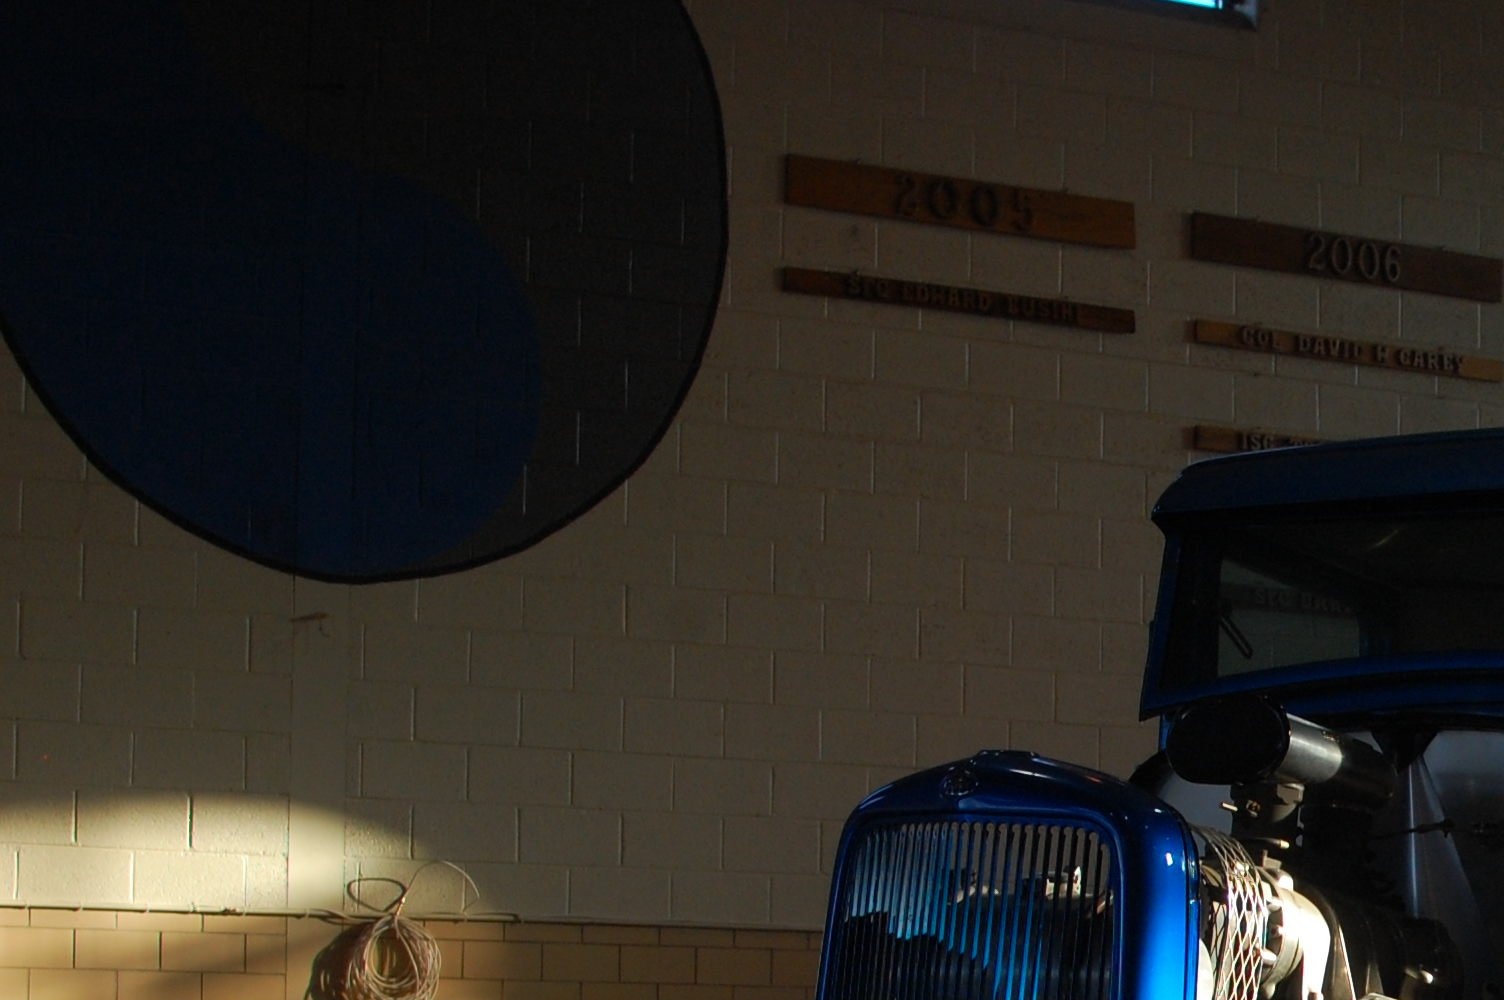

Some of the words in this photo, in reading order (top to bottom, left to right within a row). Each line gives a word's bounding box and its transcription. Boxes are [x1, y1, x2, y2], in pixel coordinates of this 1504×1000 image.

[896, 174, 1033, 232] 2005
[1307, 233, 1401, 282] 2006
[1242, 327, 1280, 349] COL
[1299, 334, 1363, 359] DAVID
